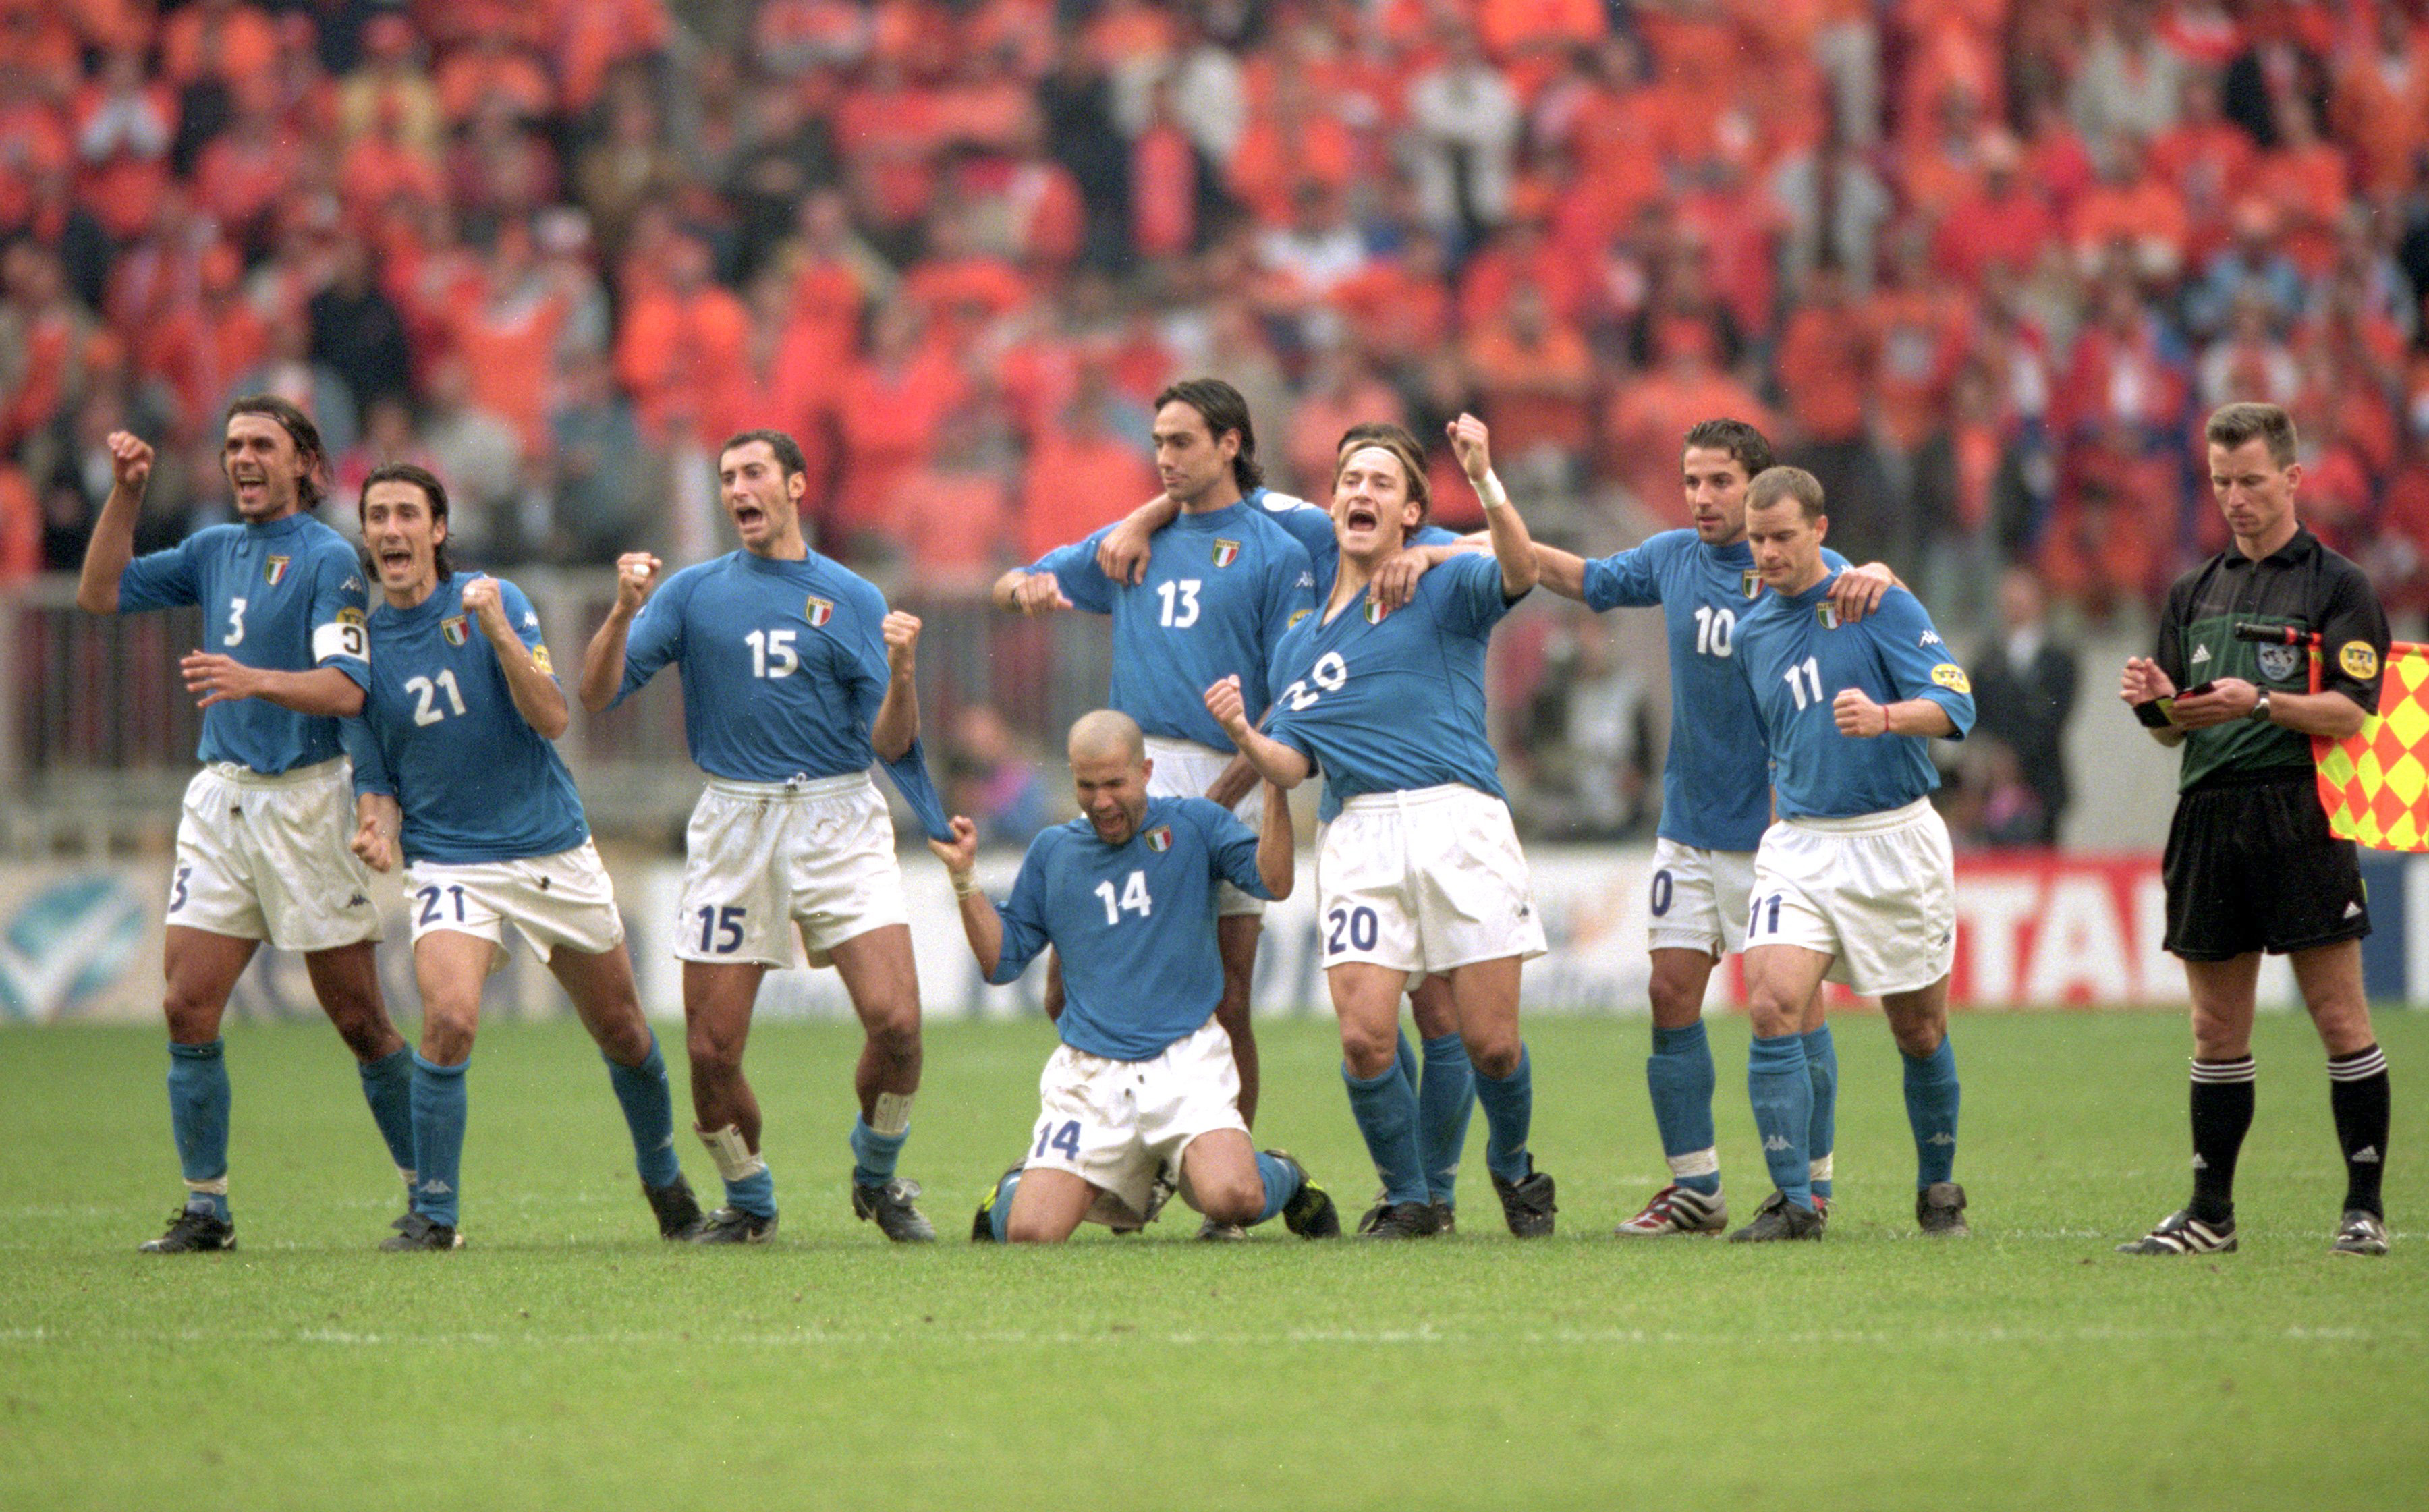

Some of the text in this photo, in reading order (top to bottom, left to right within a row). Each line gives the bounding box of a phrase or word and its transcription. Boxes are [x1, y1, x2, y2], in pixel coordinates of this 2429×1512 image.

[223, 598, 246, 646] 3
[1158, 579, 1201, 629] 13
[745, 630, 798, 678] 15
[1694, 605, 1736, 657] 10
[405, 669, 466, 727] 21
[1277, 651, 1347, 711] 20
[1784, 656, 1823, 710] 11
[169, 868, 192, 914] 3
[415, 885, 465, 927] 21
[1094, 870, 1152, 926] 14
[1651, 870, 1673, 917] 0
[698, 904, 747, 954] 15
[1328, 905, 1378, 955] 20
[1748, 894, 1783, 939] 11
[1035, 1119, 1082, 1161] 14
